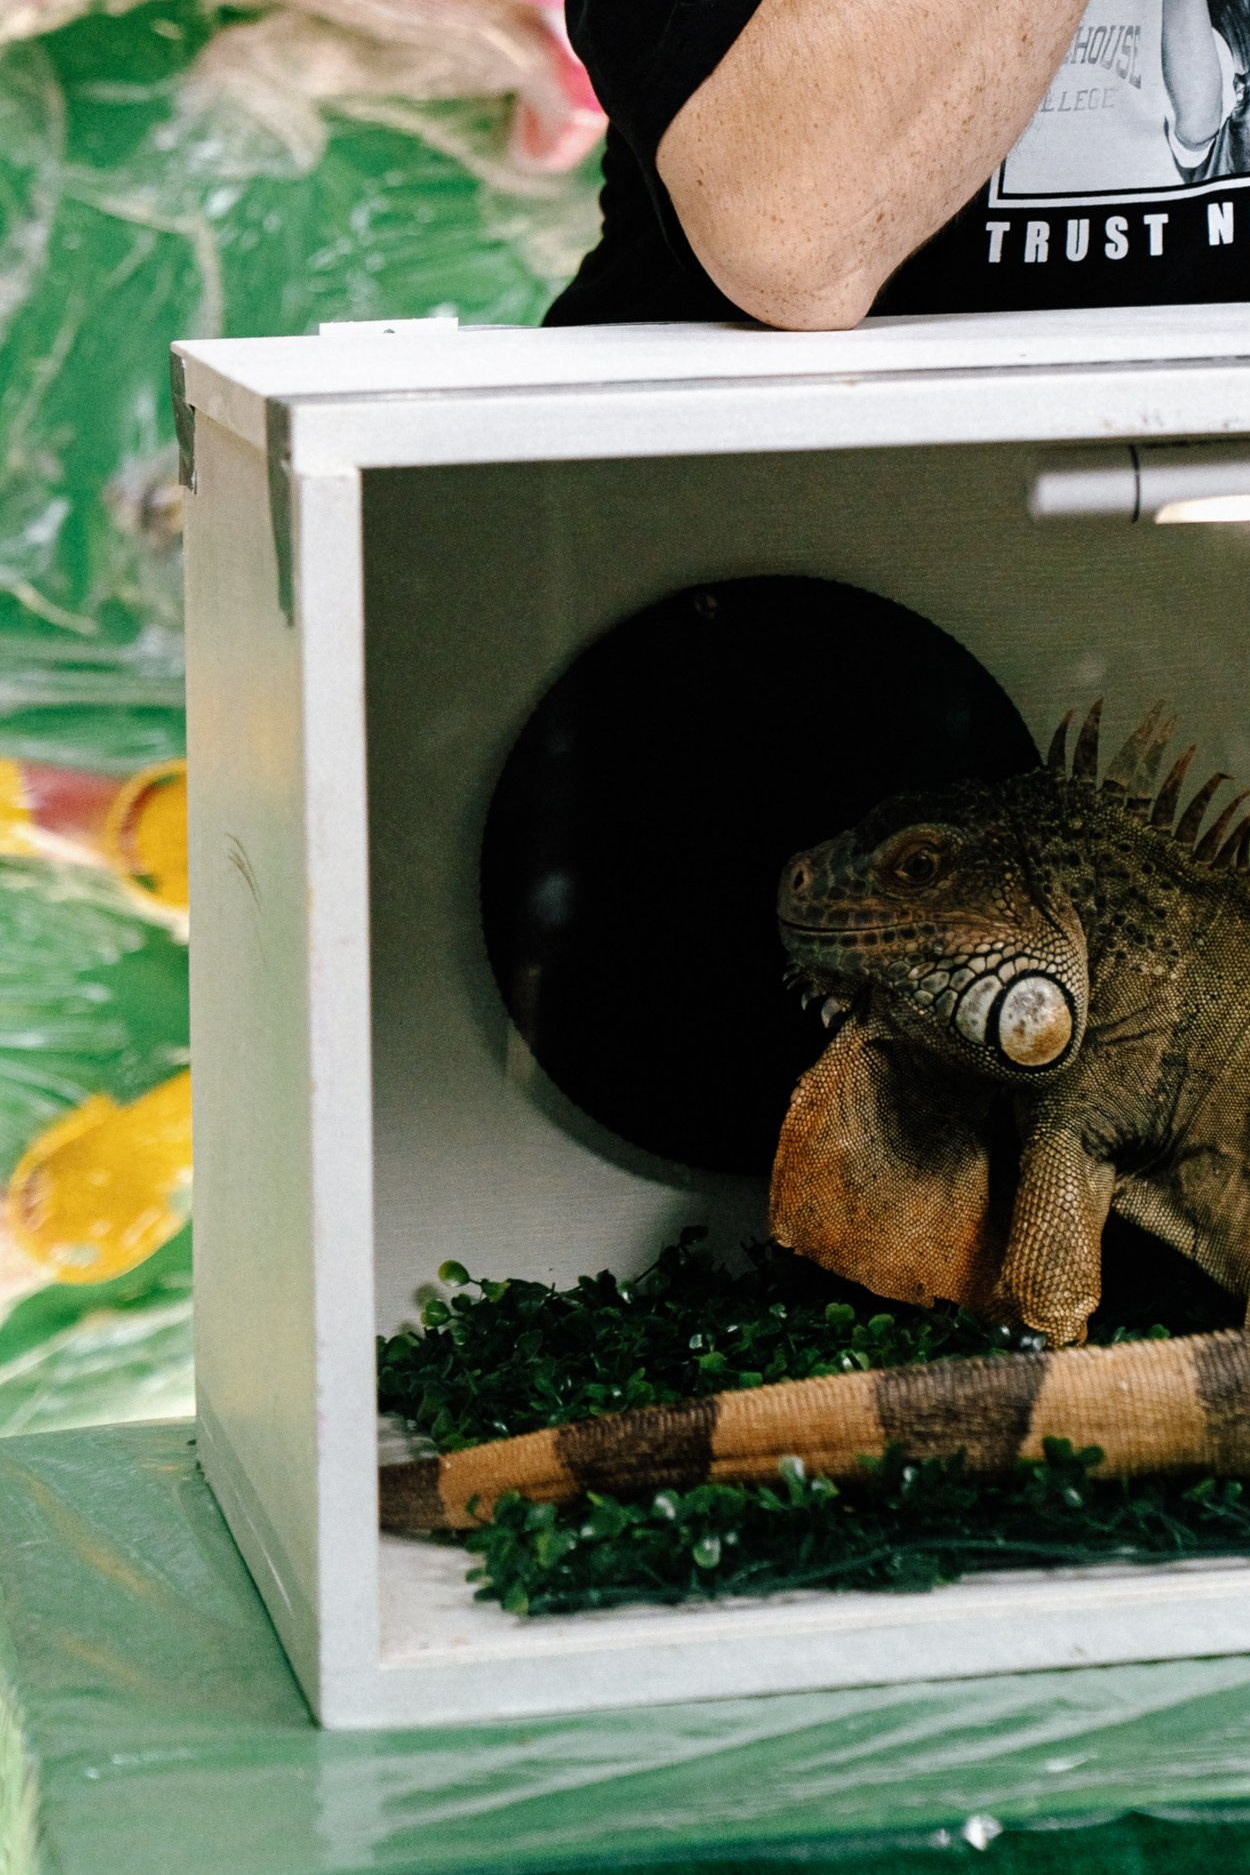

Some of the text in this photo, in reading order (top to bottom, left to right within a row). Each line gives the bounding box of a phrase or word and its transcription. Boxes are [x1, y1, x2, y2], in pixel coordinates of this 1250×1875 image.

[1064, 24, 1142, 90] HOUSE
[1040, 87, 1119, 112] LLEGE
[985, 212, 1170, 264] TRUST
